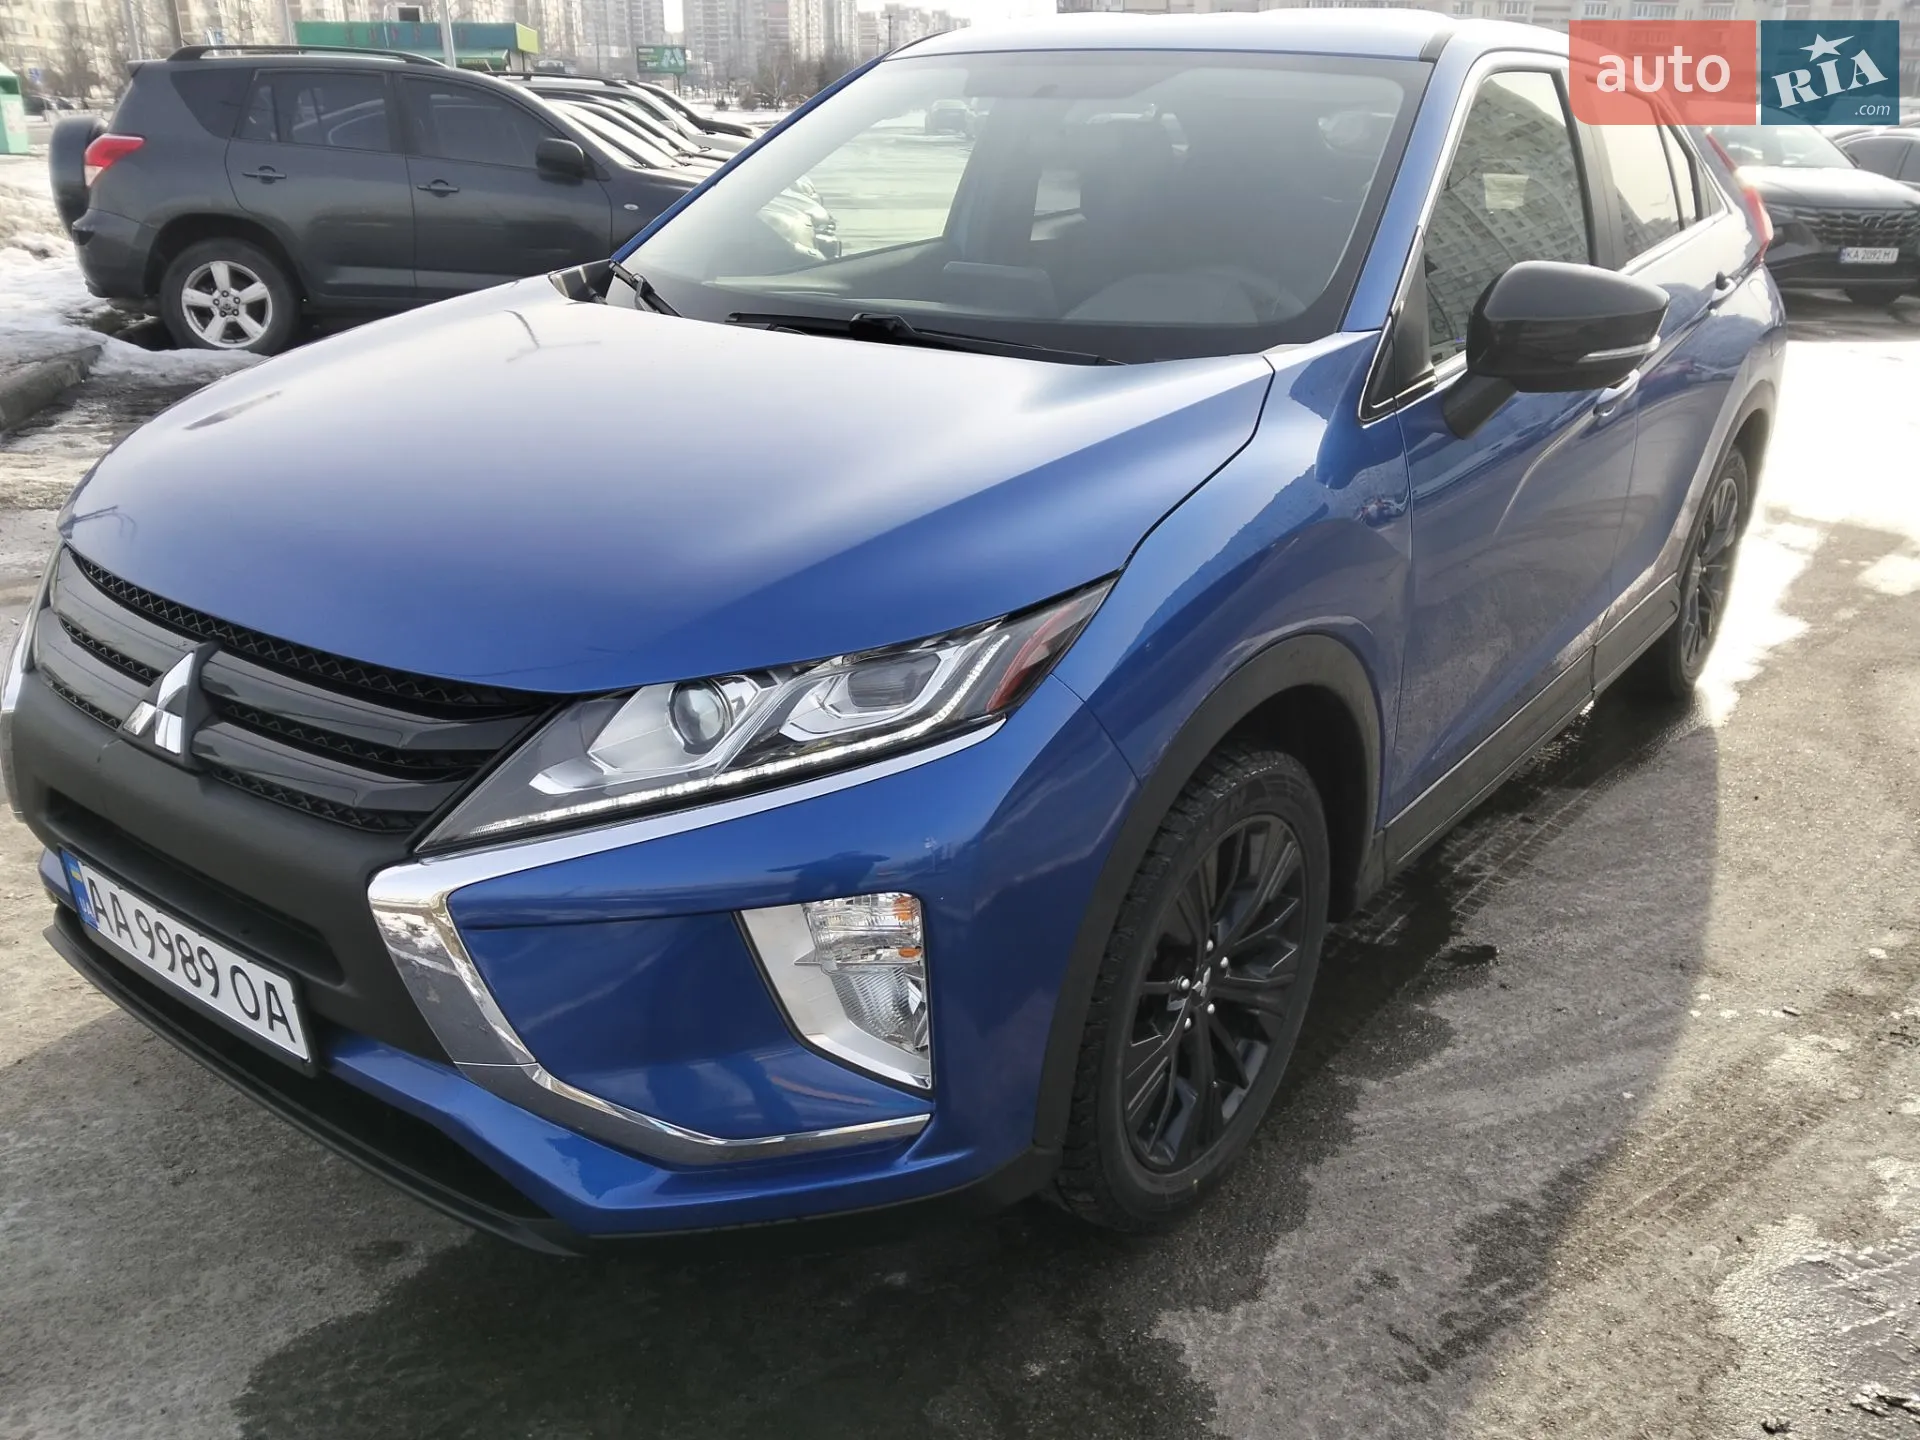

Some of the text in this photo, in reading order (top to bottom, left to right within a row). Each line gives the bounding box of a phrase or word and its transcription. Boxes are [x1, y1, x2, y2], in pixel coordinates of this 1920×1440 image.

[87, 877, 296, 1043] AA 9989 OA
